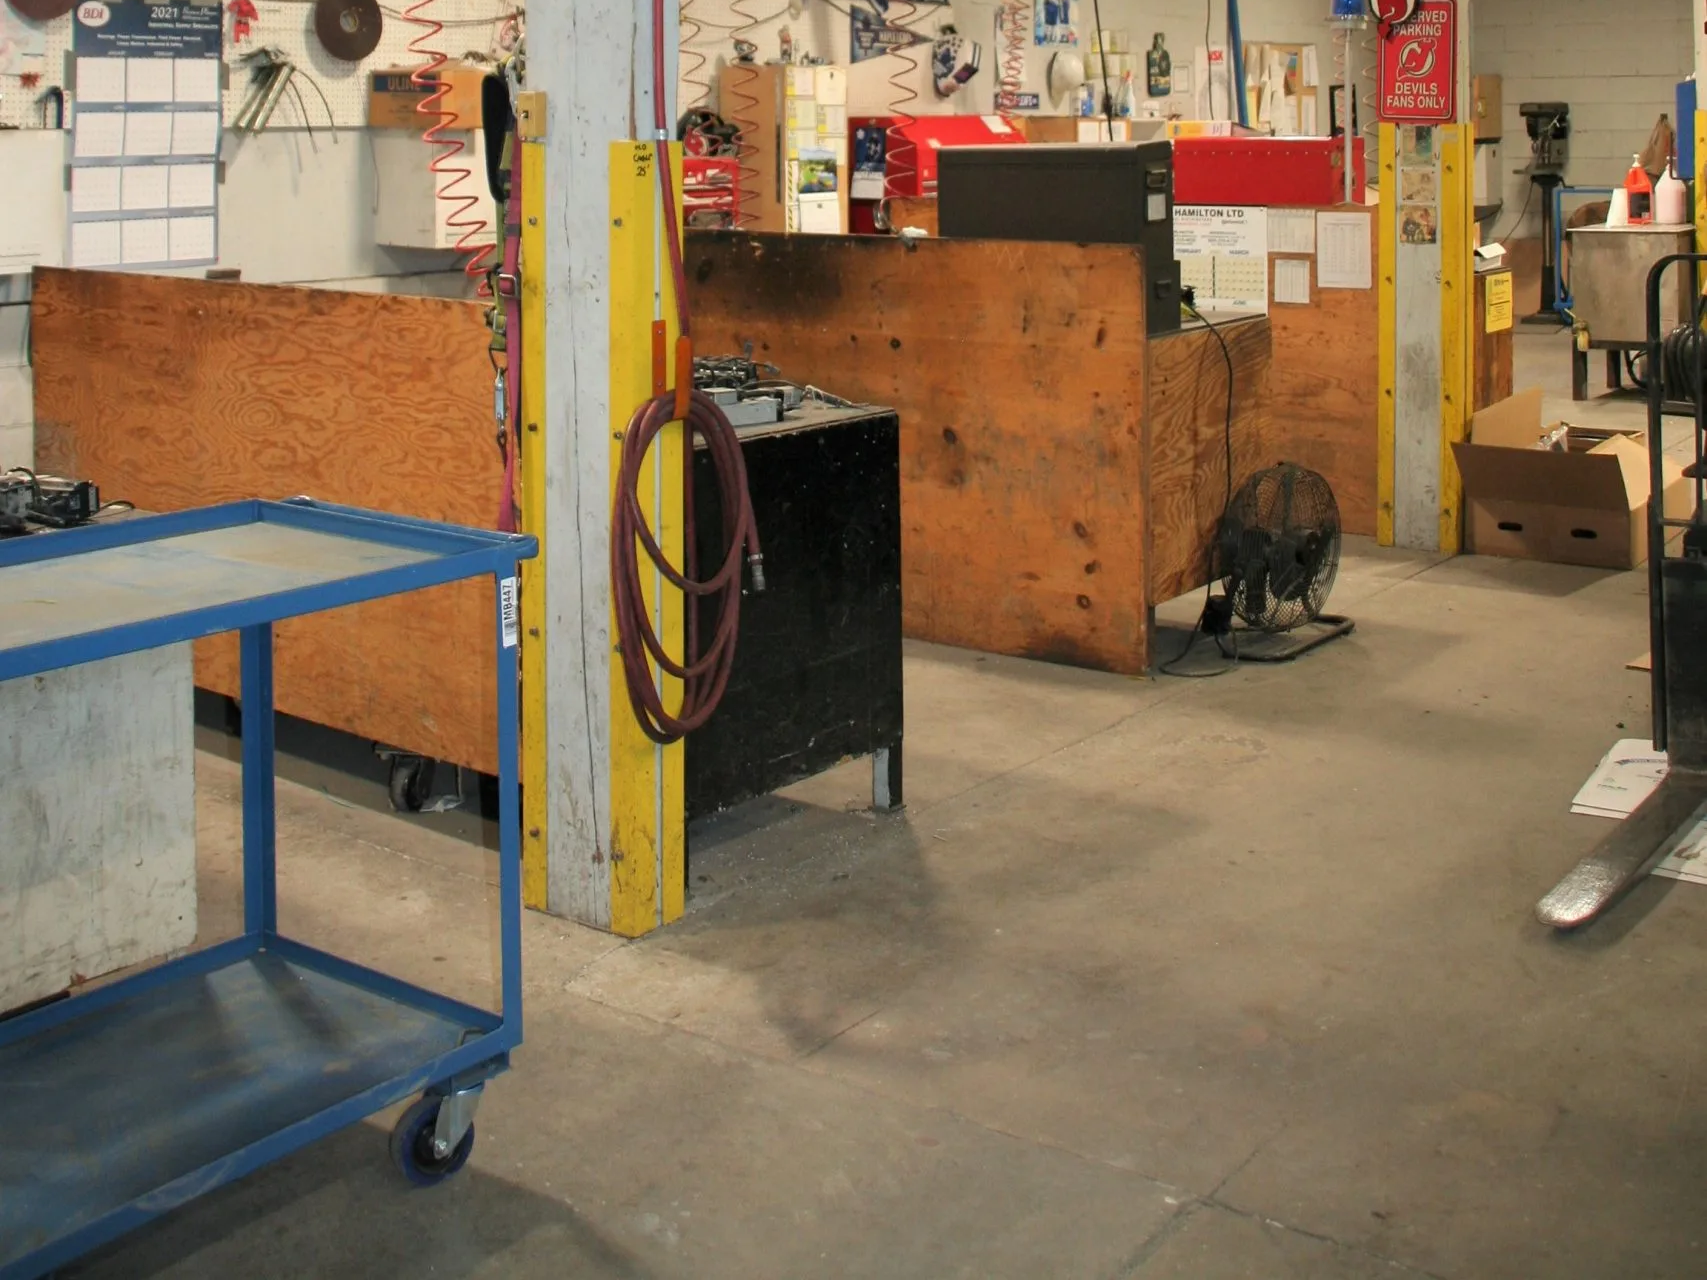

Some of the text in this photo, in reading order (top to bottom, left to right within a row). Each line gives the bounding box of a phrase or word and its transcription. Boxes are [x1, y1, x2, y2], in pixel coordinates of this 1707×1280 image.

[83, 7, 105, 19] BDI
[151, 6, 178, 19] 2021
[1411, 10, 1448, 23] ERVED
[1393, 24, 1442, 37] PARKING
[1394, 82, 1438, 95] DEVILS
[1386, 95, 1446, 109] FANS ONLY
[1174, 208, 1245, 218] HAMILTON LTD
